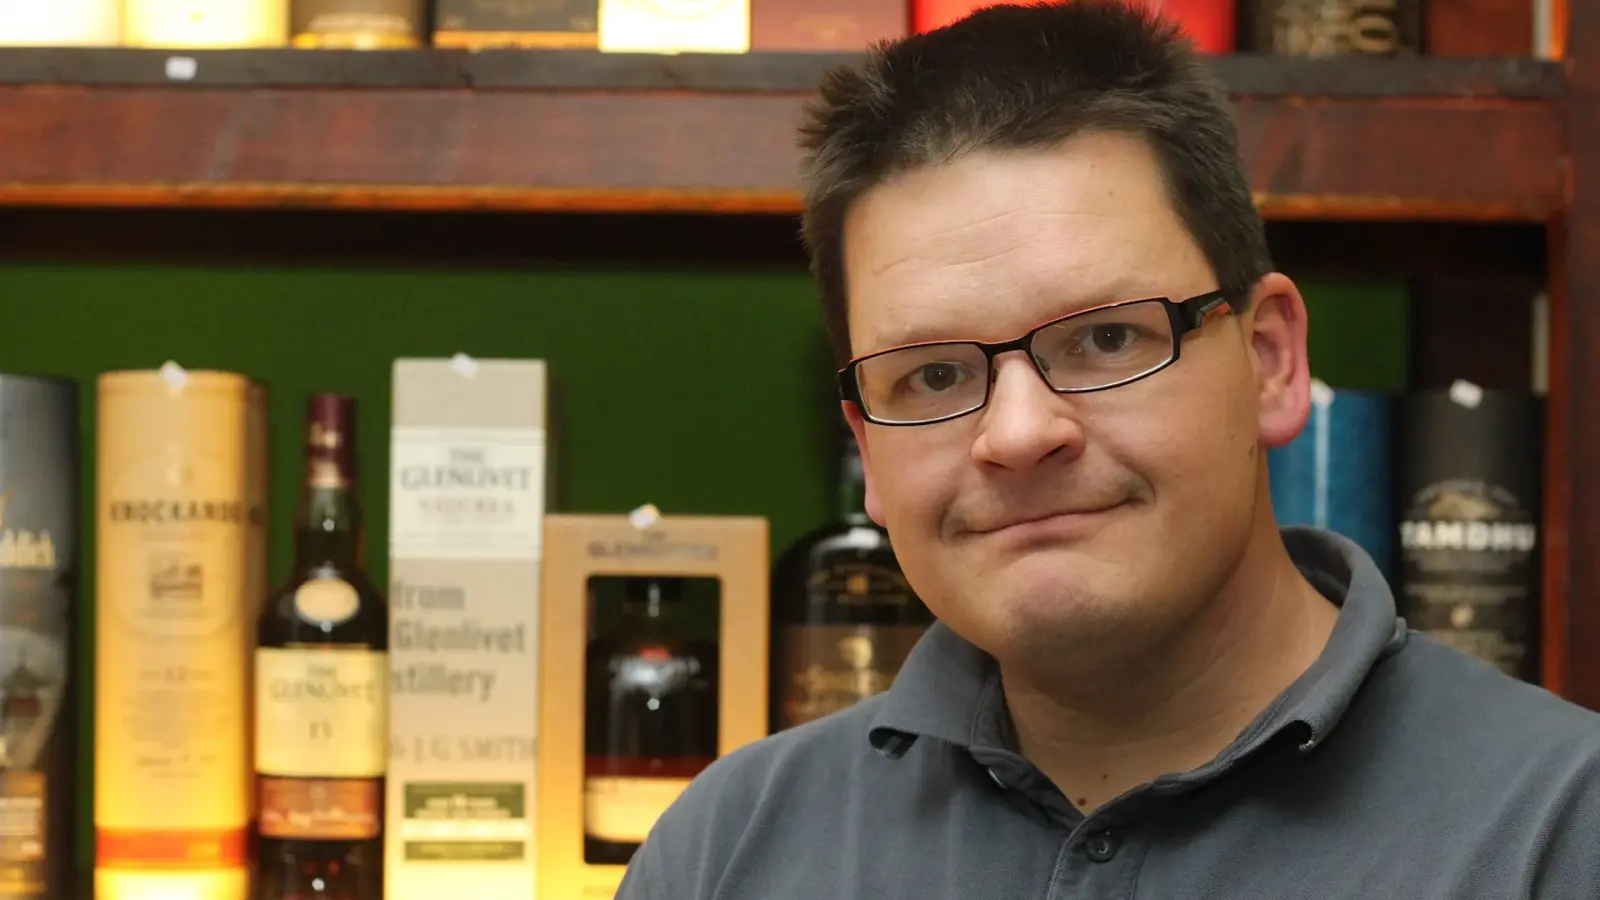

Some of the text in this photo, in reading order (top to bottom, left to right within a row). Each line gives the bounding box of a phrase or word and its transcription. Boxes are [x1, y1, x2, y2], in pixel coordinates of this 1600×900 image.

[400, 465, 532, 491] GLENLIVET
[1400, 520, 1537, 551] TAMDHU
[393, 619, 526, 654] Glenlivet
